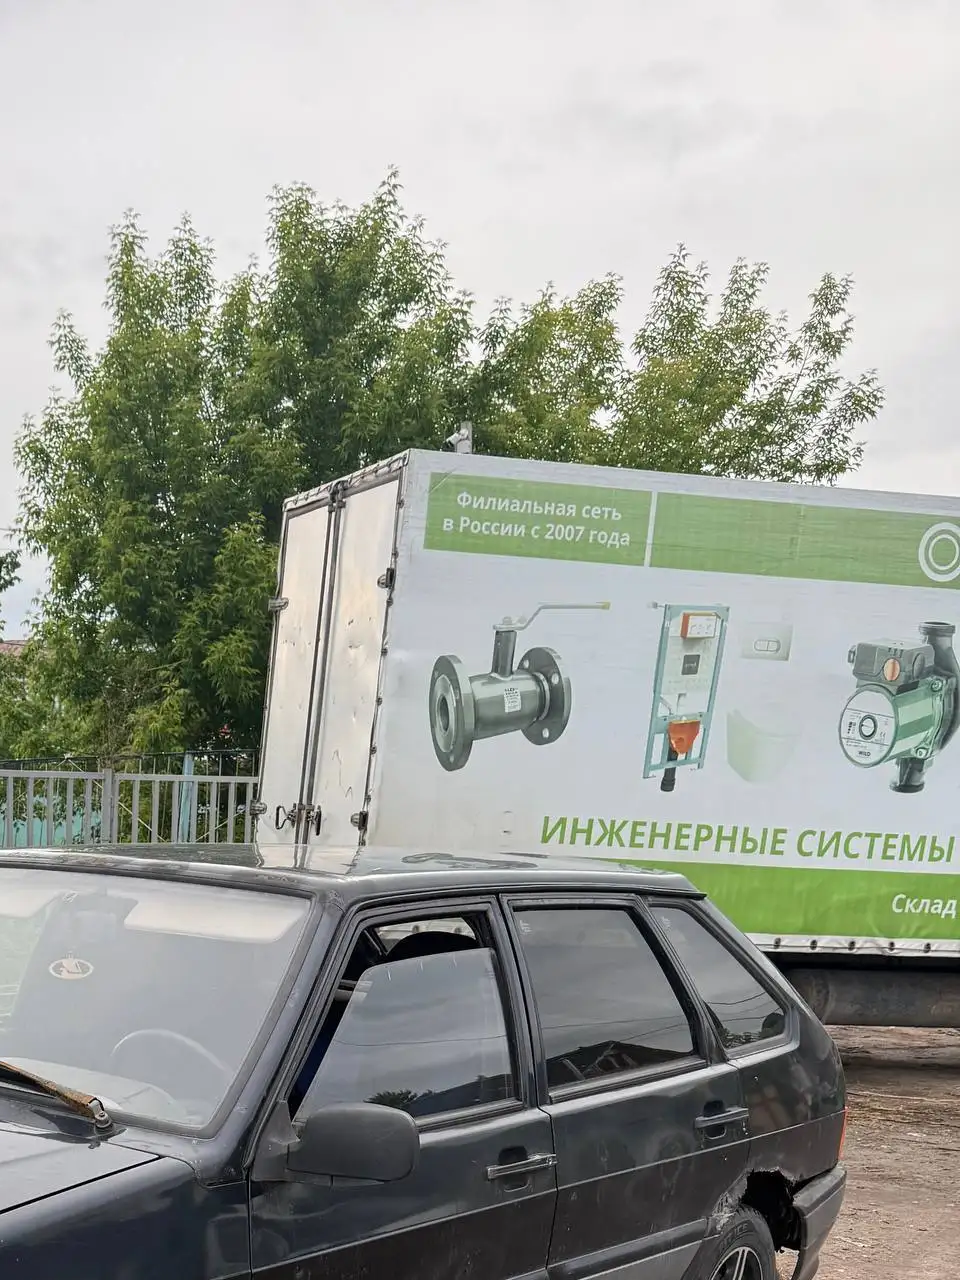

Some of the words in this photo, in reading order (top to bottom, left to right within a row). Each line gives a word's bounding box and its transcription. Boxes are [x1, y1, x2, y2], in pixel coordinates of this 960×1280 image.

[456, 491, 576, 517] Филиальная
[582, 504, 622, 521] сеть
[442, 517, 454, 531] в
[459, 516, 525, 537] России
[531, 526, 540, 538] с
[544, 523, 585, 542] 2007
[589, 531, 630, 548] года
[540, 815, 788, 856] ИНЖЕНЕРНЫЕ
[796, 828, 956, 863] СИСТЕМЫ
[891, 893, 957, 919] Склад
